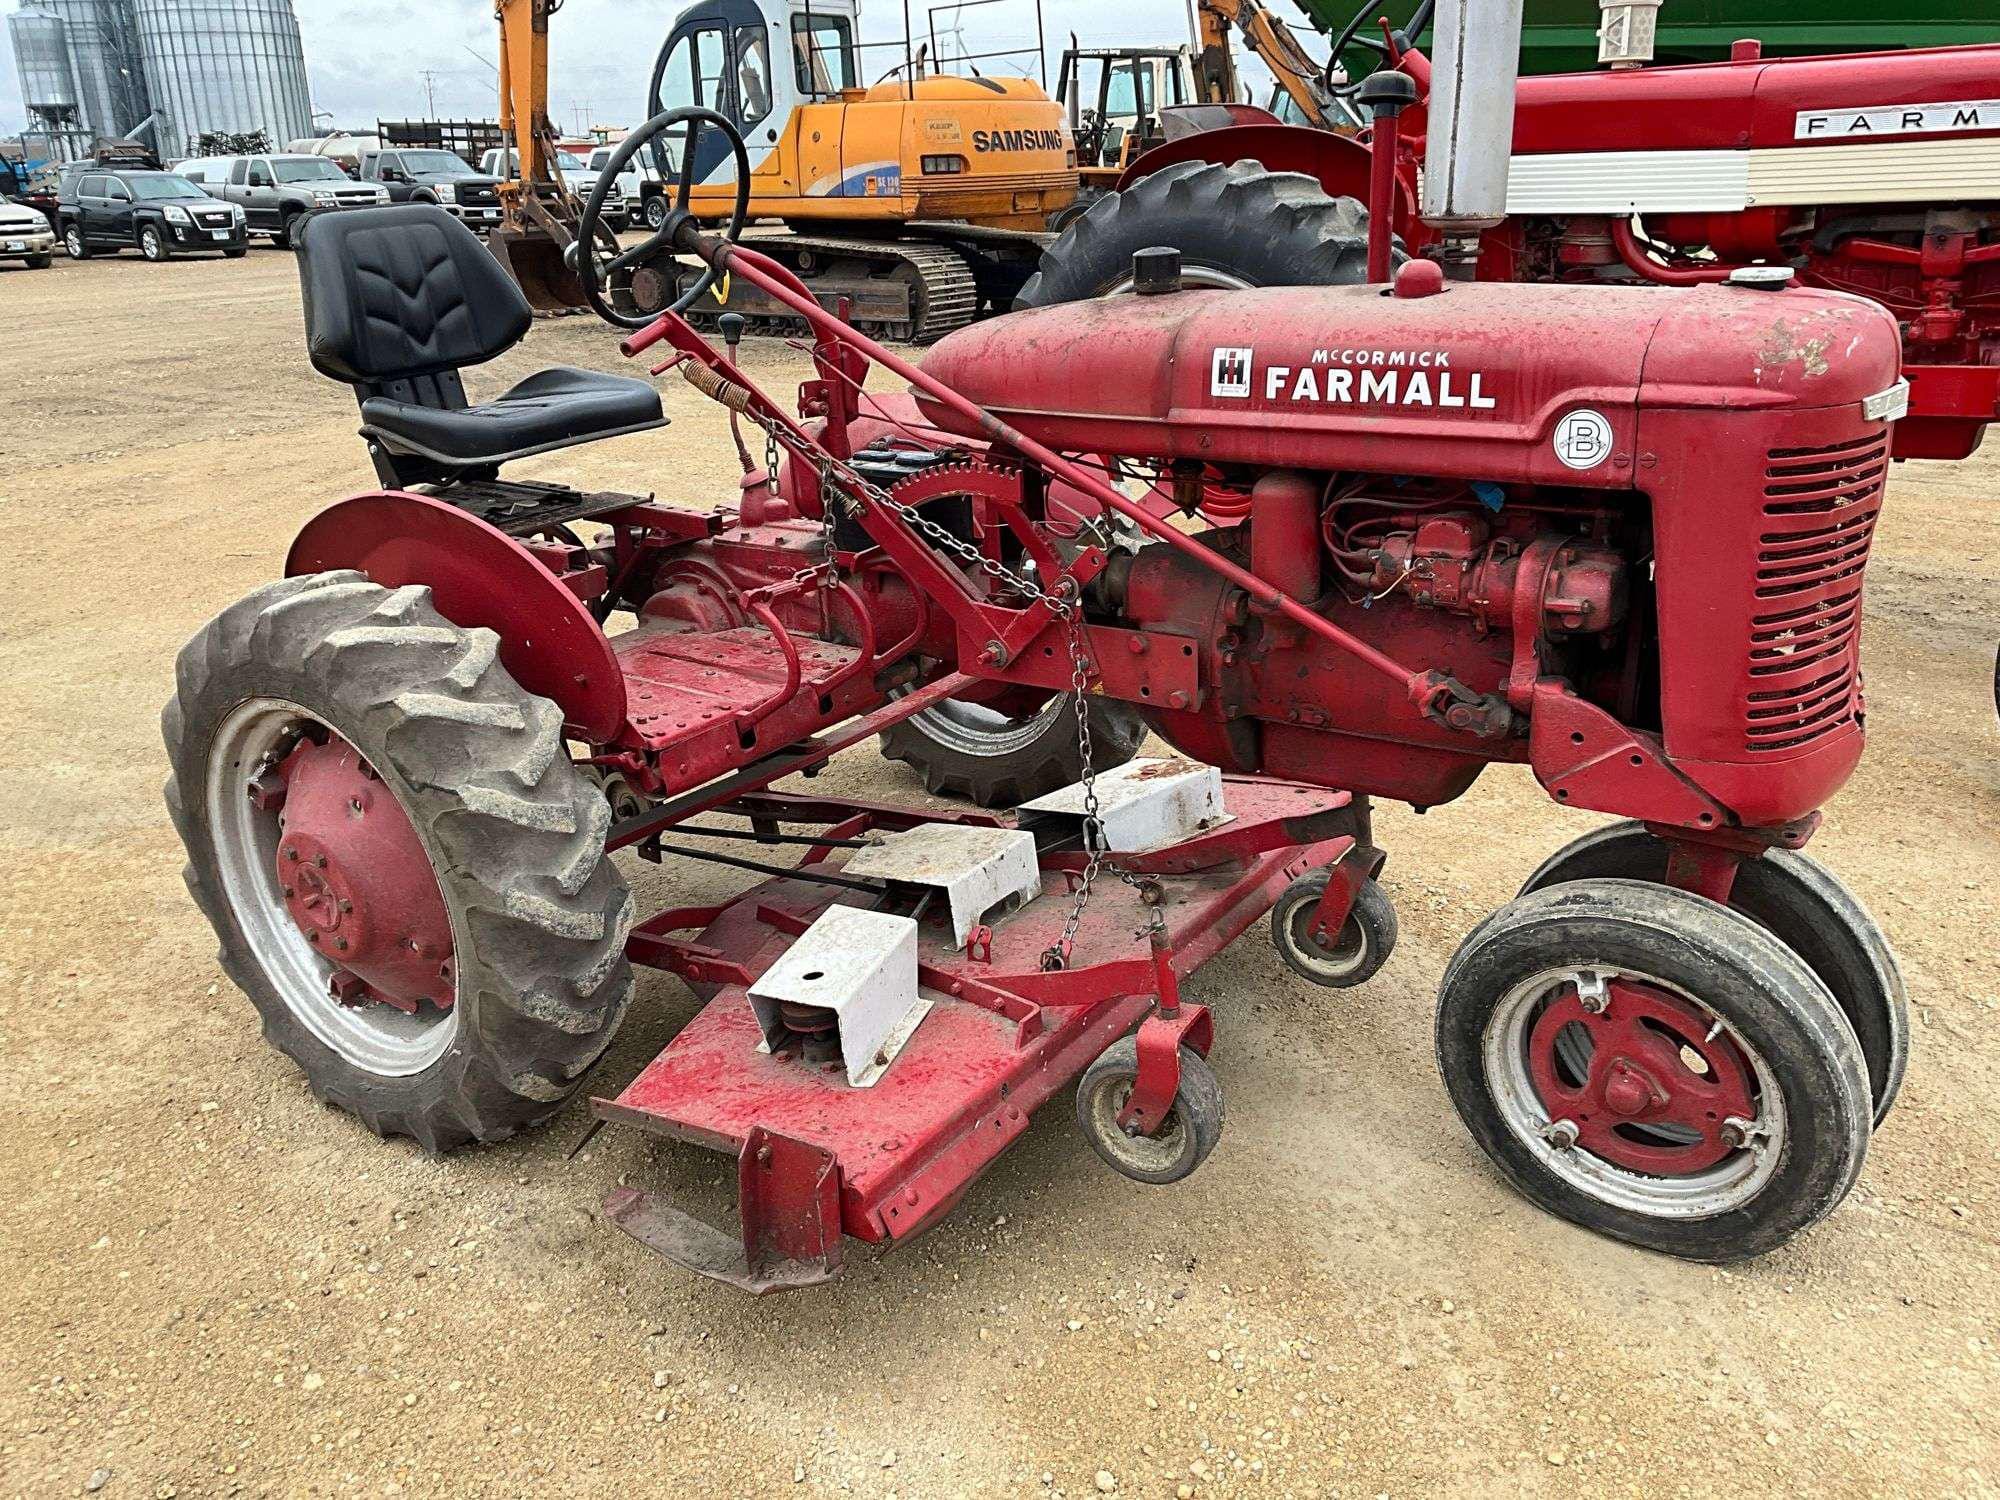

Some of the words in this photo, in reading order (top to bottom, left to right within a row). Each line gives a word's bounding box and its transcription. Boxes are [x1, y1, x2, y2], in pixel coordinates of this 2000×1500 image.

[971, 129, 1063, 153] SAMSUNG
[1265, 366, 1496, 409] FARMALL
[1567, 419, 1601, 459] B
